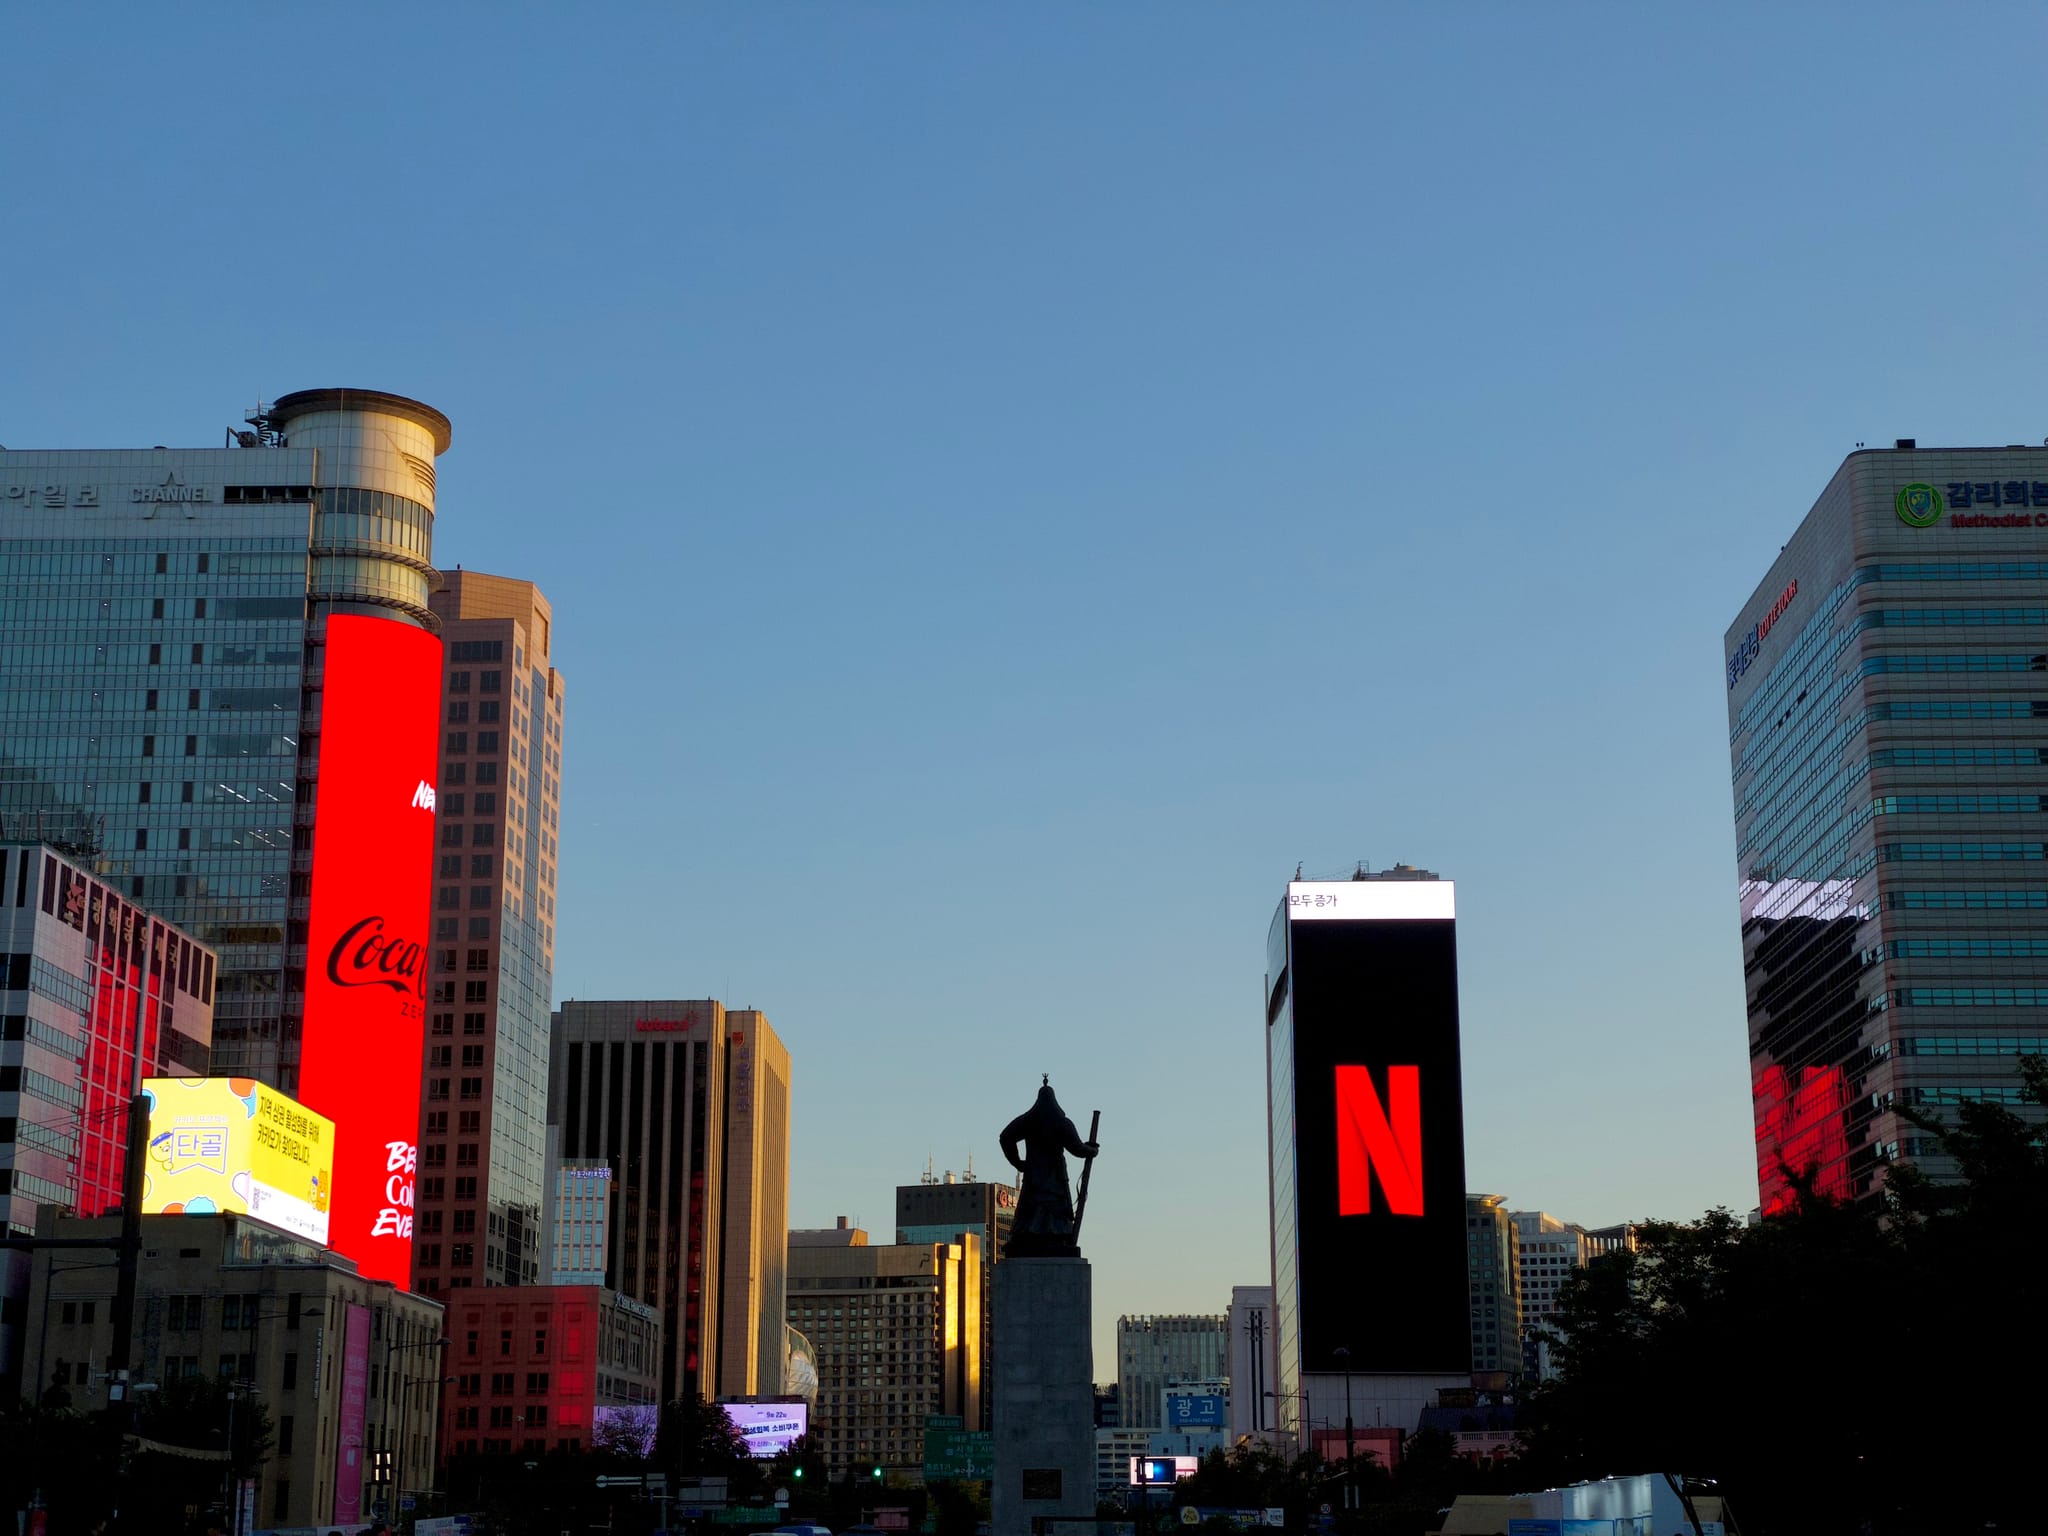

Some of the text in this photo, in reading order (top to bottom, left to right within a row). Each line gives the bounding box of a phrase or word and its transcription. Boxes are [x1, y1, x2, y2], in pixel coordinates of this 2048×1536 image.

[130, 487, 213, 502] CHANNEL
[1952, 513, 2032, 528] Methodist
[1290, 895, 1338, 907] 모두 증가
[259, 1096, 320, 1144] 지역 상권 활성화를 위해
[177, 1134, 222, 1158] 단골
[257, 1123, 281, 1152] 카카오가
[1335, 1064, 1425, 1216] N
[772, 1422, 799, 1432] 소비쿠폰
